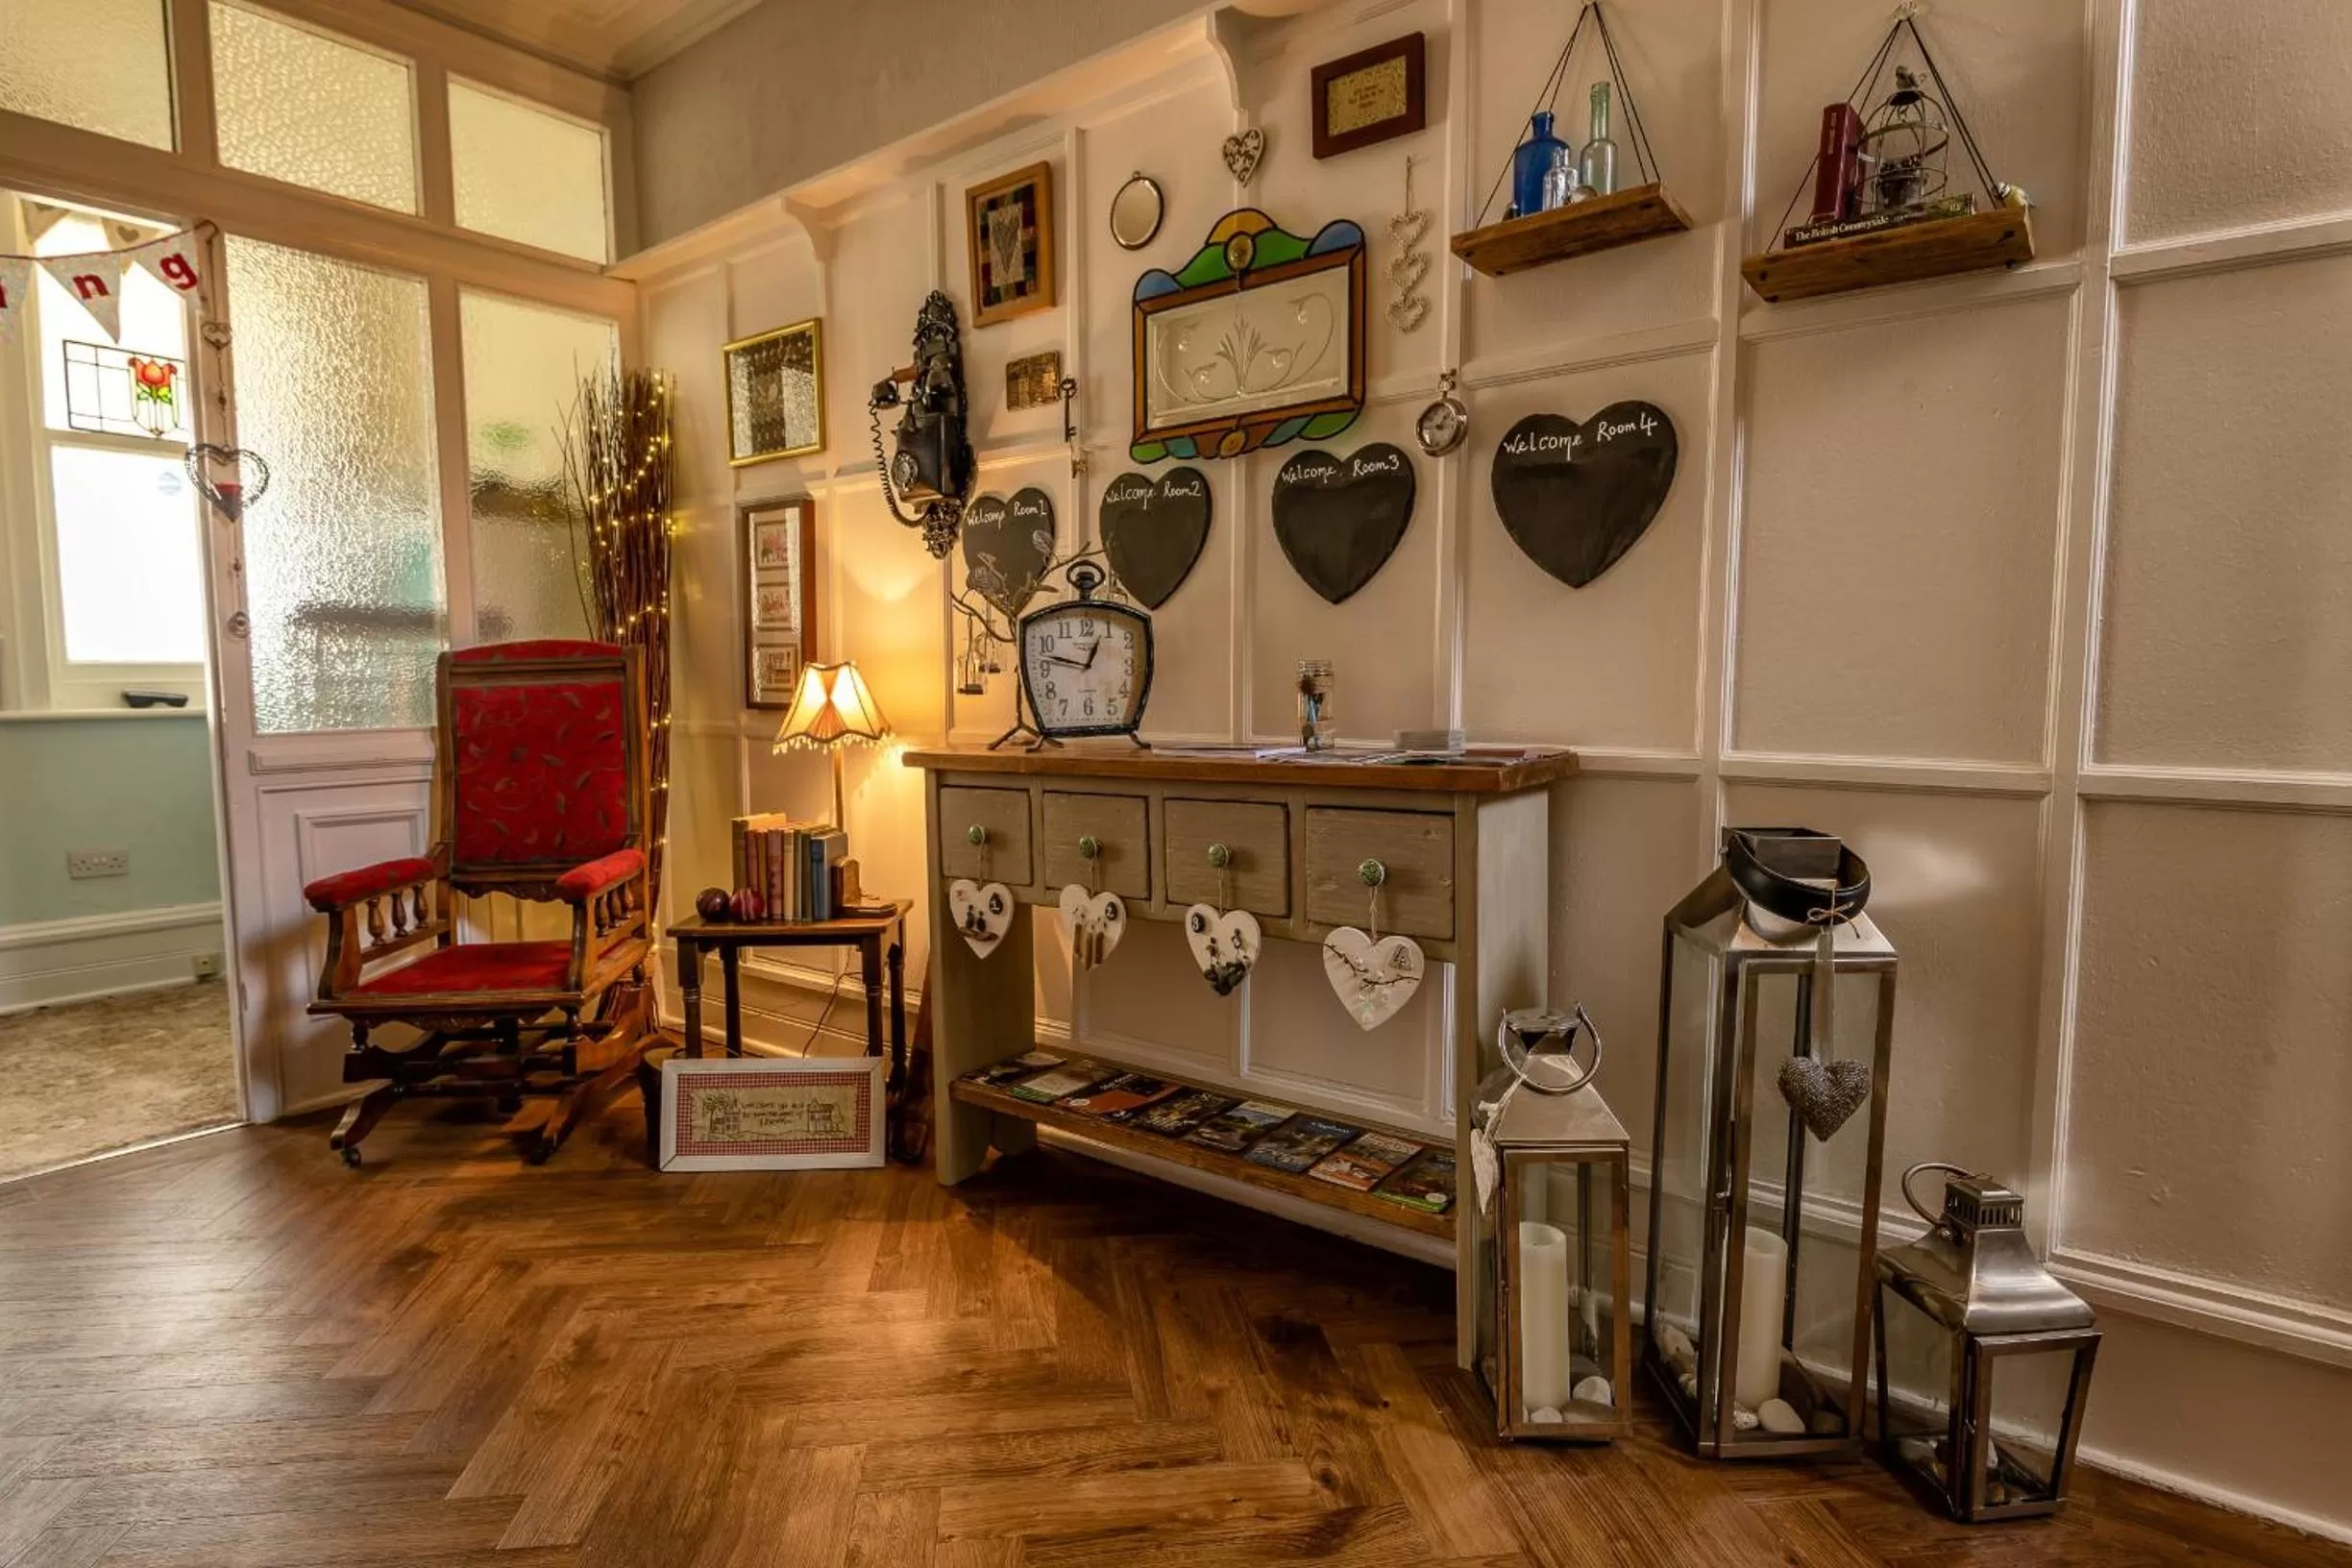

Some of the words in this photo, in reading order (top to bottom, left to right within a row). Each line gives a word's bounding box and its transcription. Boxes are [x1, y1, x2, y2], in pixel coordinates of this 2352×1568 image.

[1504, 432, 1583, 461] Welcome
[1282, 465, 1337, 484] Welcome
[1058, 622, 1072, 639] 11
[1079, 619, 1094, 637] 12
[1106, 622, 1113, 639] 1
[1040, 635, 1055, 654] 10
[1124, 631, 1134, 649] 2
[1045, 680, 1056, 699] 8
[1118, 683, 1130, 698] 4
[1059, 698, 1068, 716] 7
[1084, 698, 1094, 716] 6
[1107, 698, 1117, 716] 5
